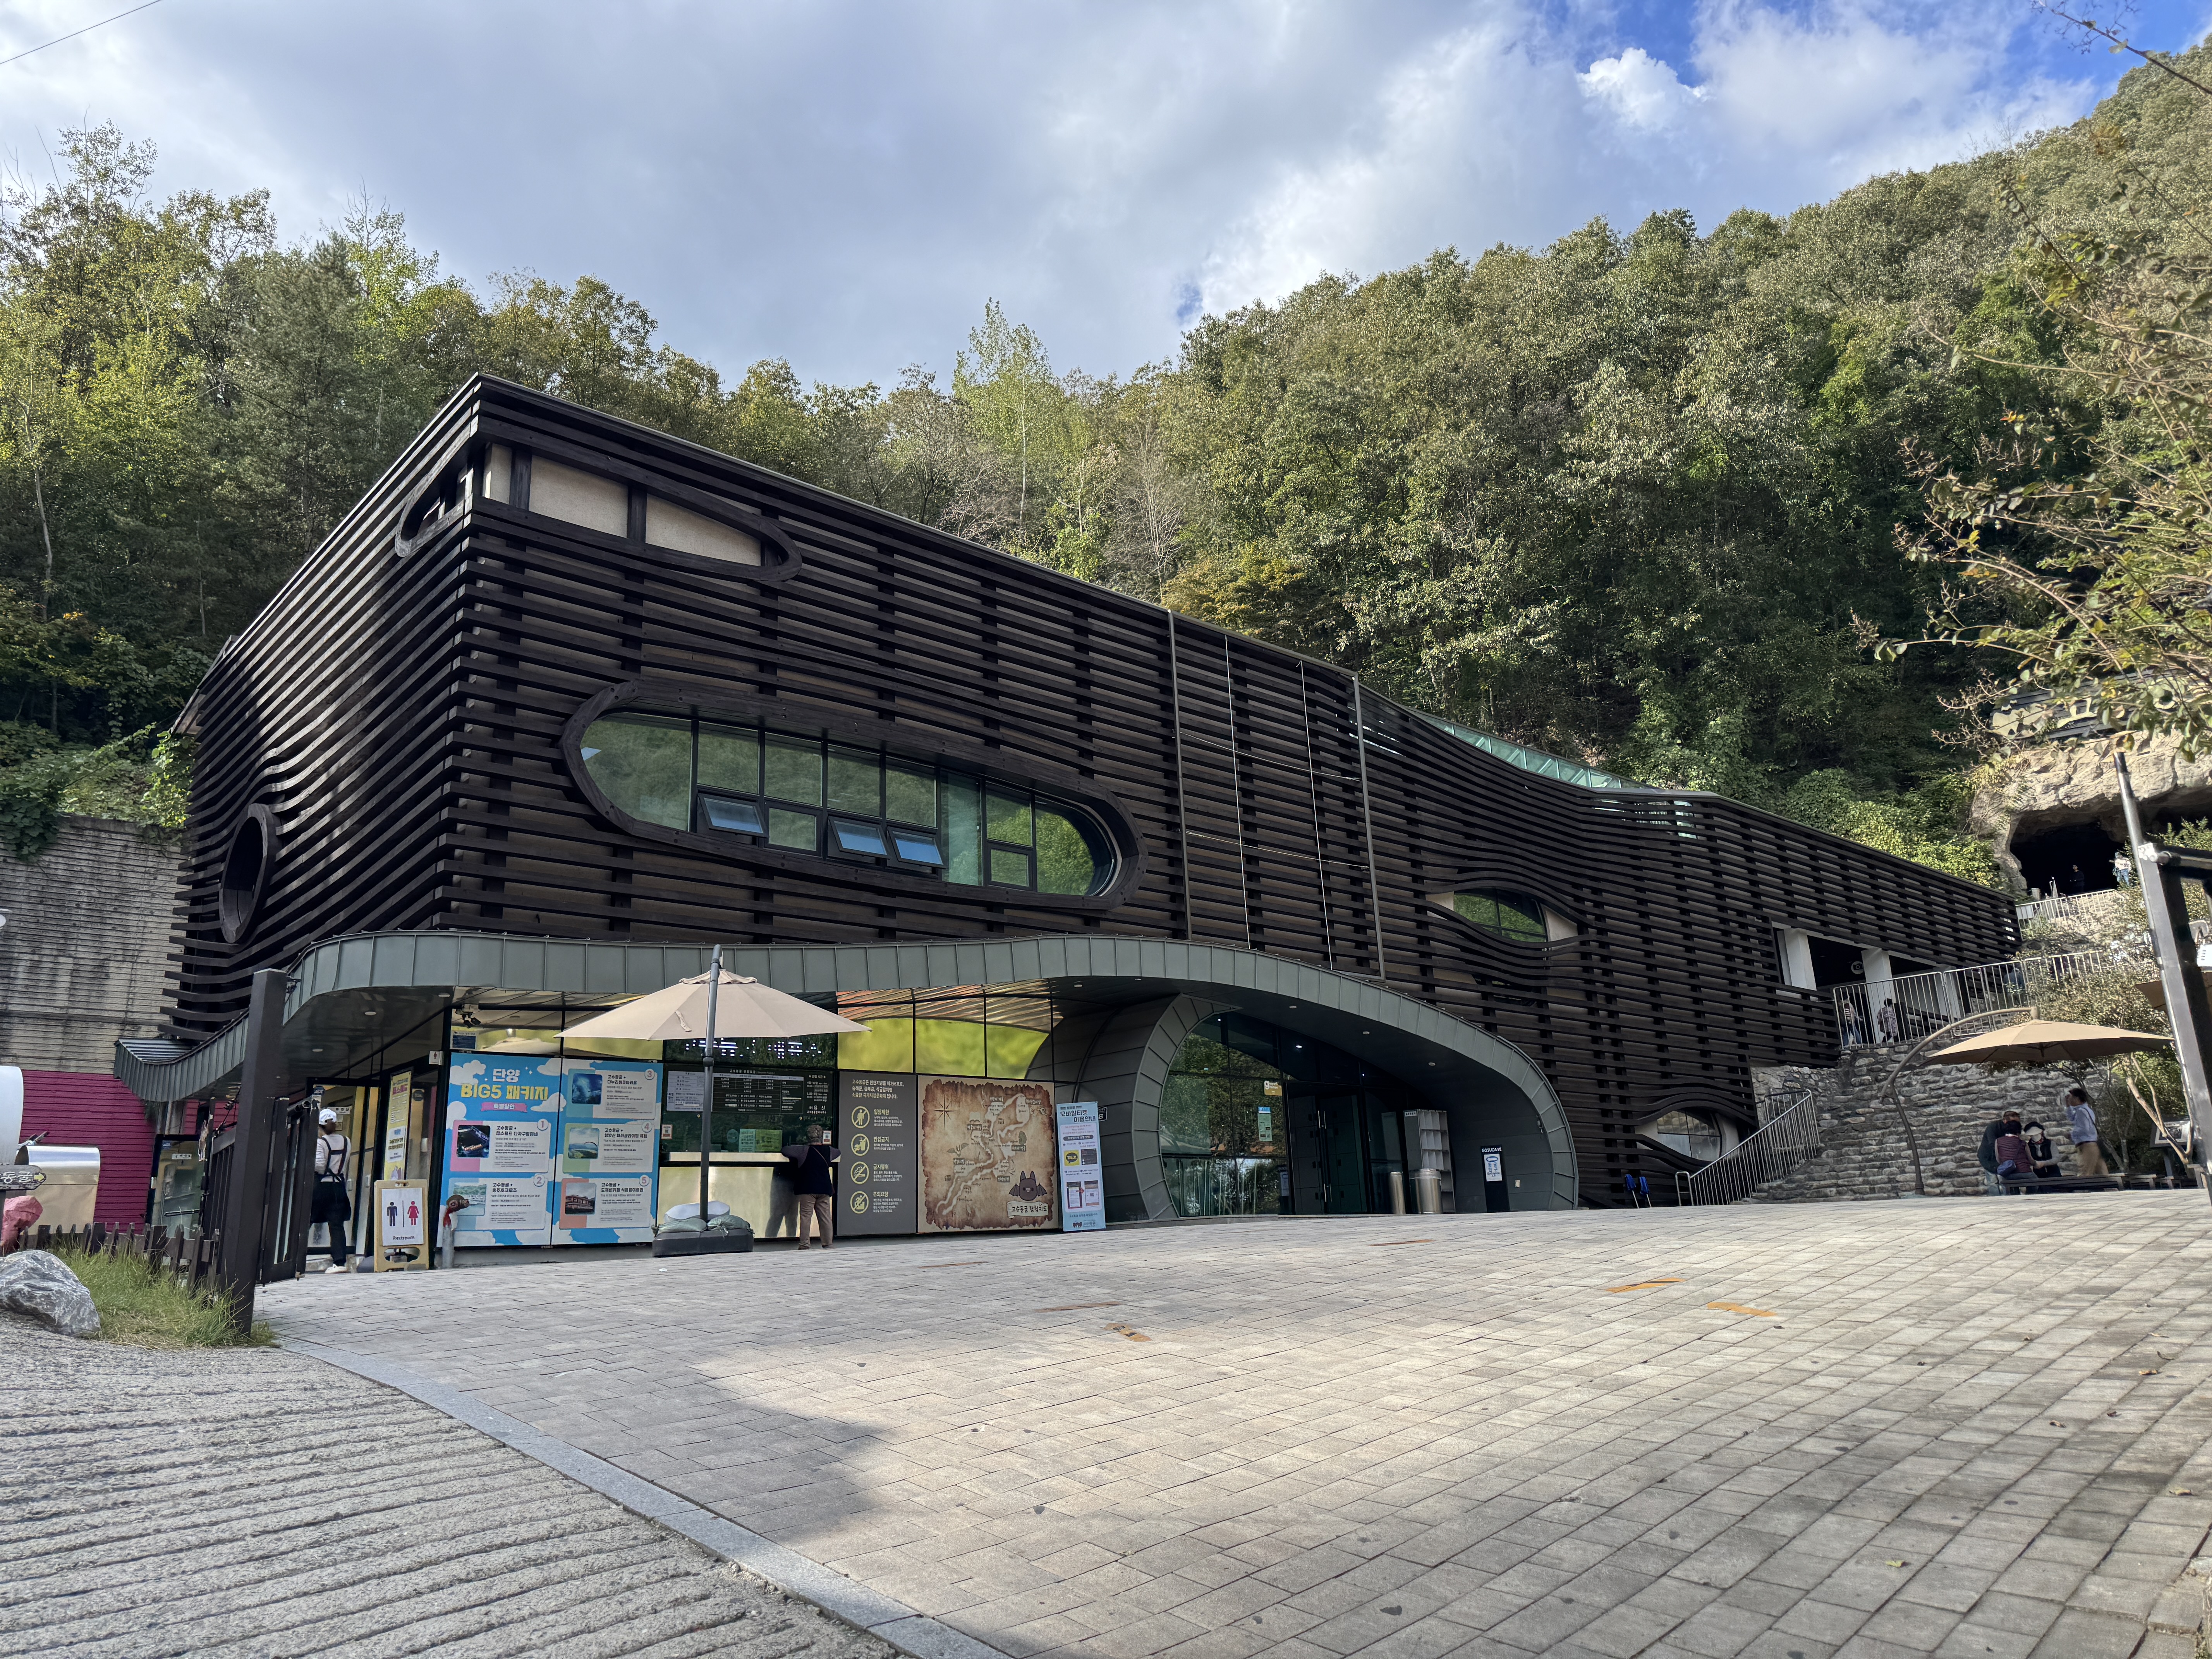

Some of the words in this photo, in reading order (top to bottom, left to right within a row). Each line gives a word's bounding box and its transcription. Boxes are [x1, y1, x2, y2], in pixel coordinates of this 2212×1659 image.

[493, 1068, 520, 1082] 단양
[461, 1084, 501, 1099] BIG5
[506, 1085, 548, 1100] 패키지
[0, 1171, 35, 1184] 동굴
